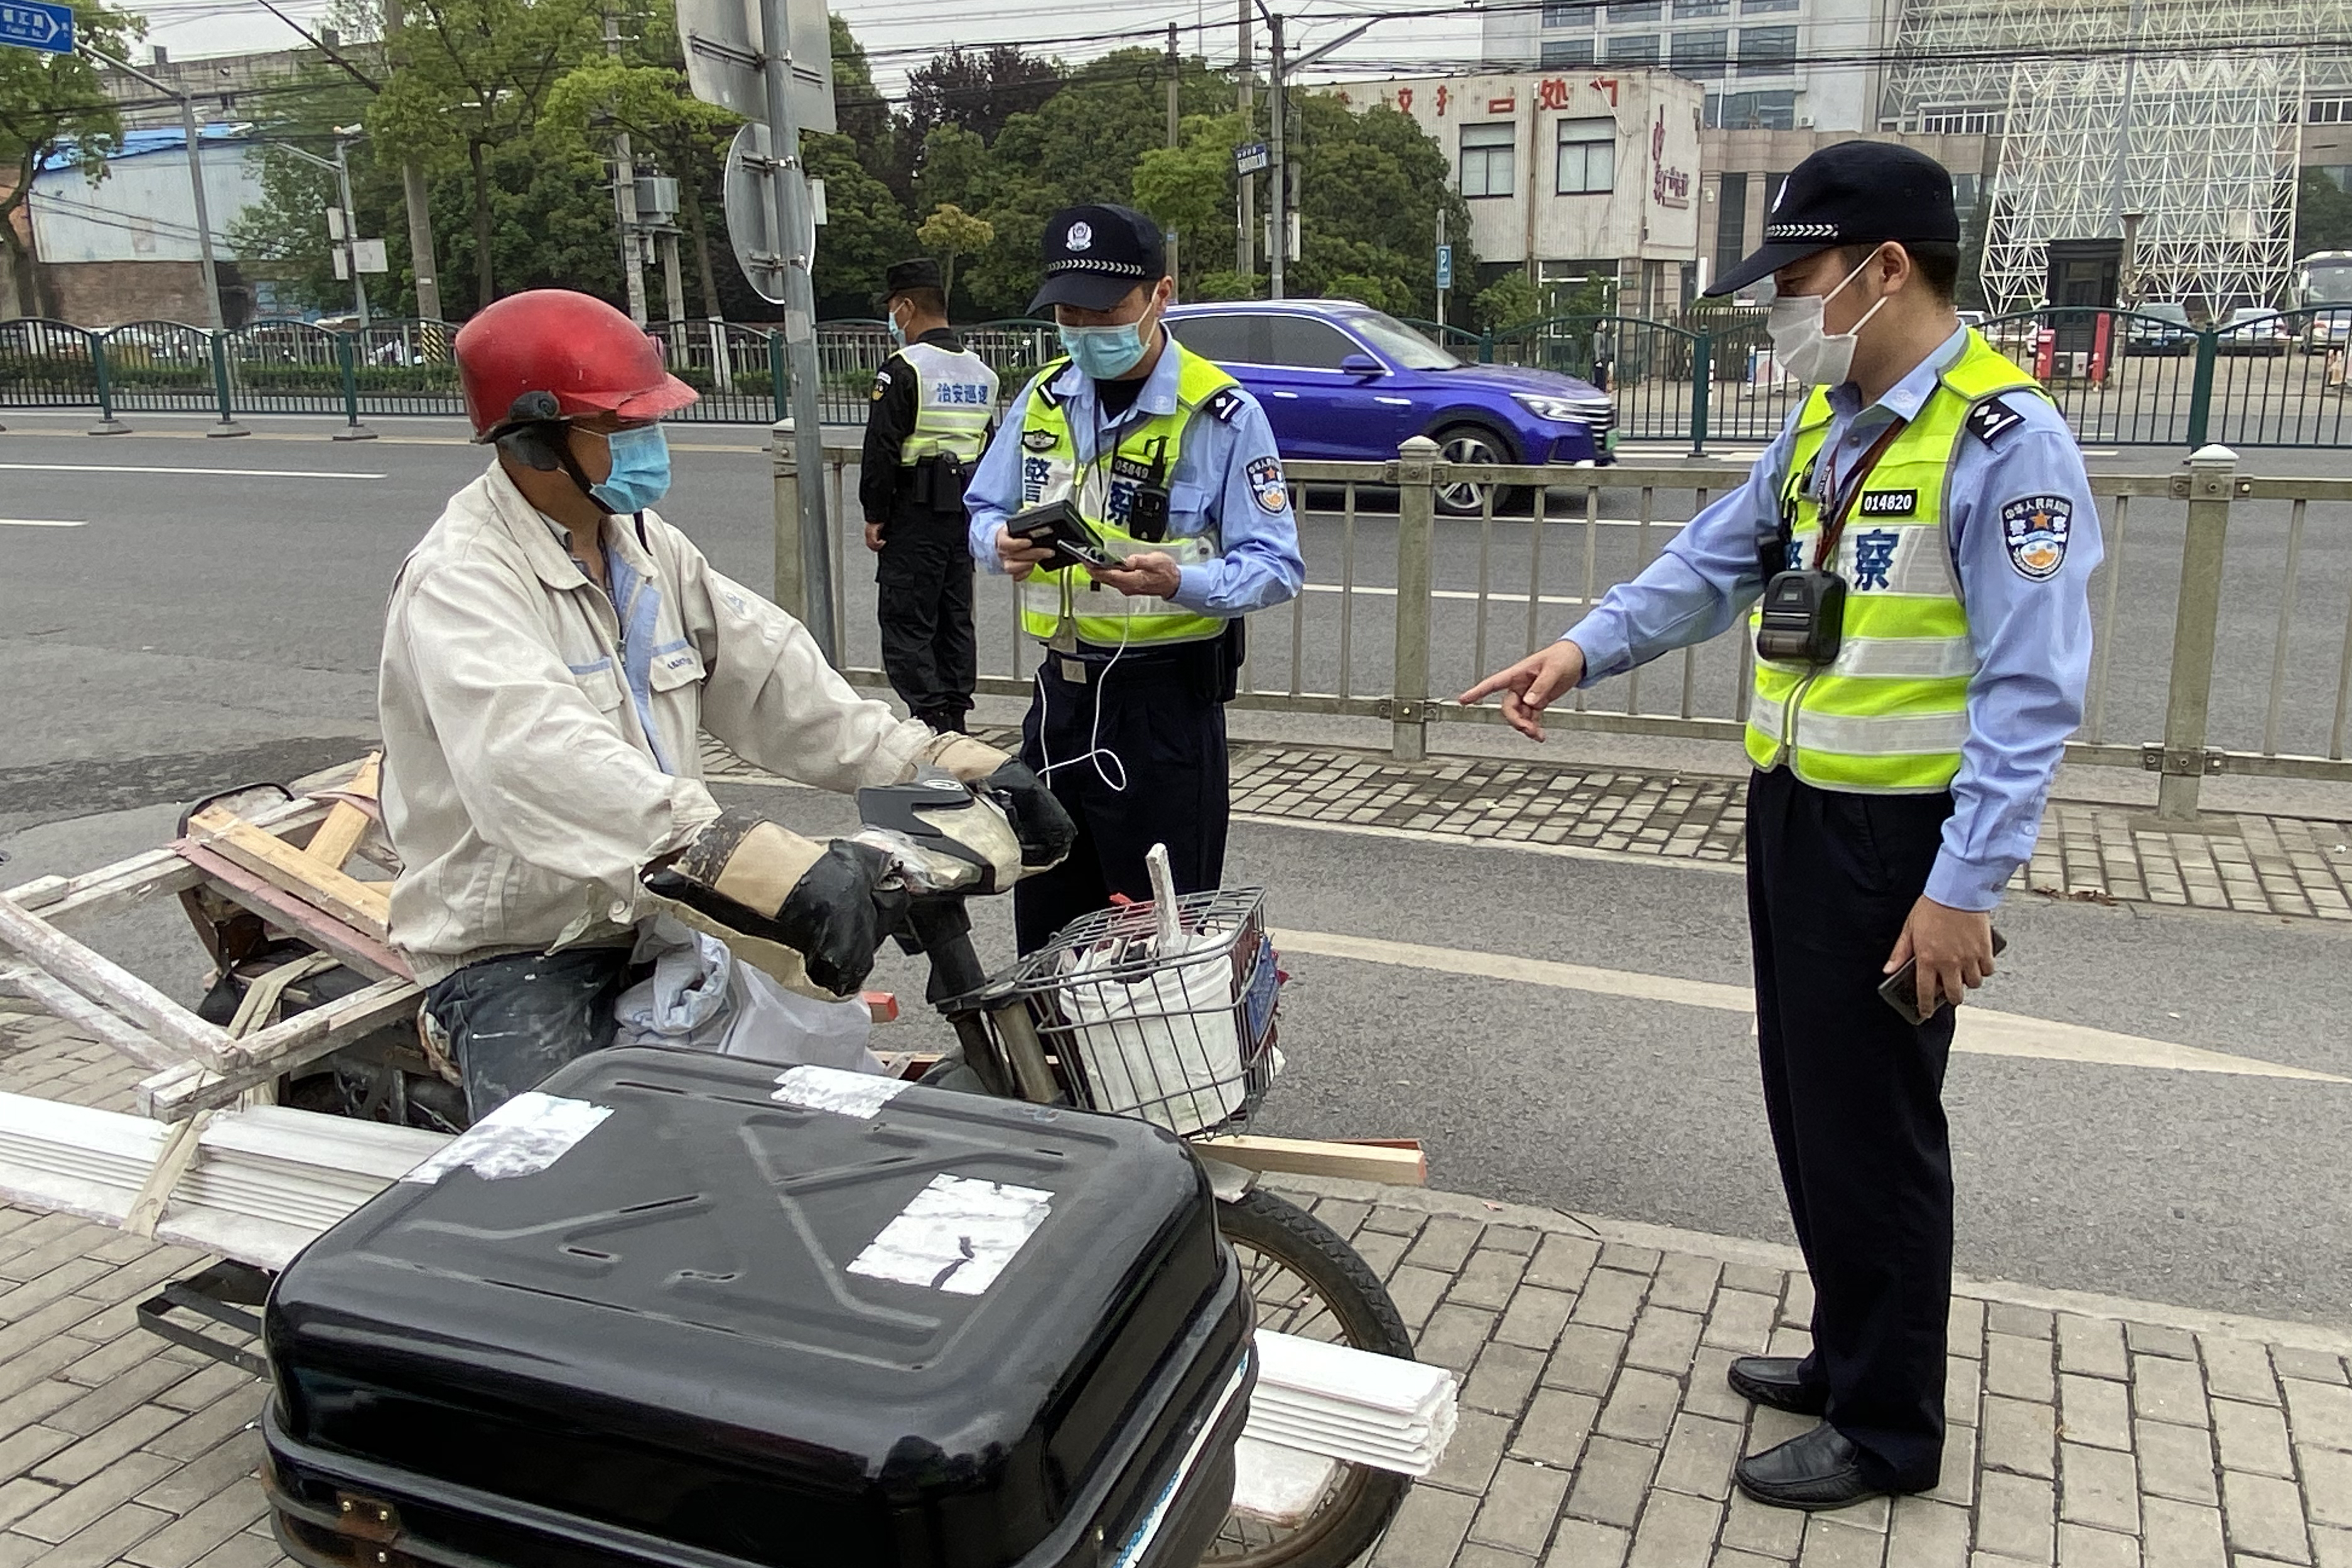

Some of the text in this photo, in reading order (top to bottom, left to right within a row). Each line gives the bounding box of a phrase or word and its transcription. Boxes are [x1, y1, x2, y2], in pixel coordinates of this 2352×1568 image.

[1025, 456, 1052, 503] 警
[1114, 459, 1150, 478] 05849
[1864, 495, 1912, 511] 014820
[1855, 528, 1900, 591] 察
